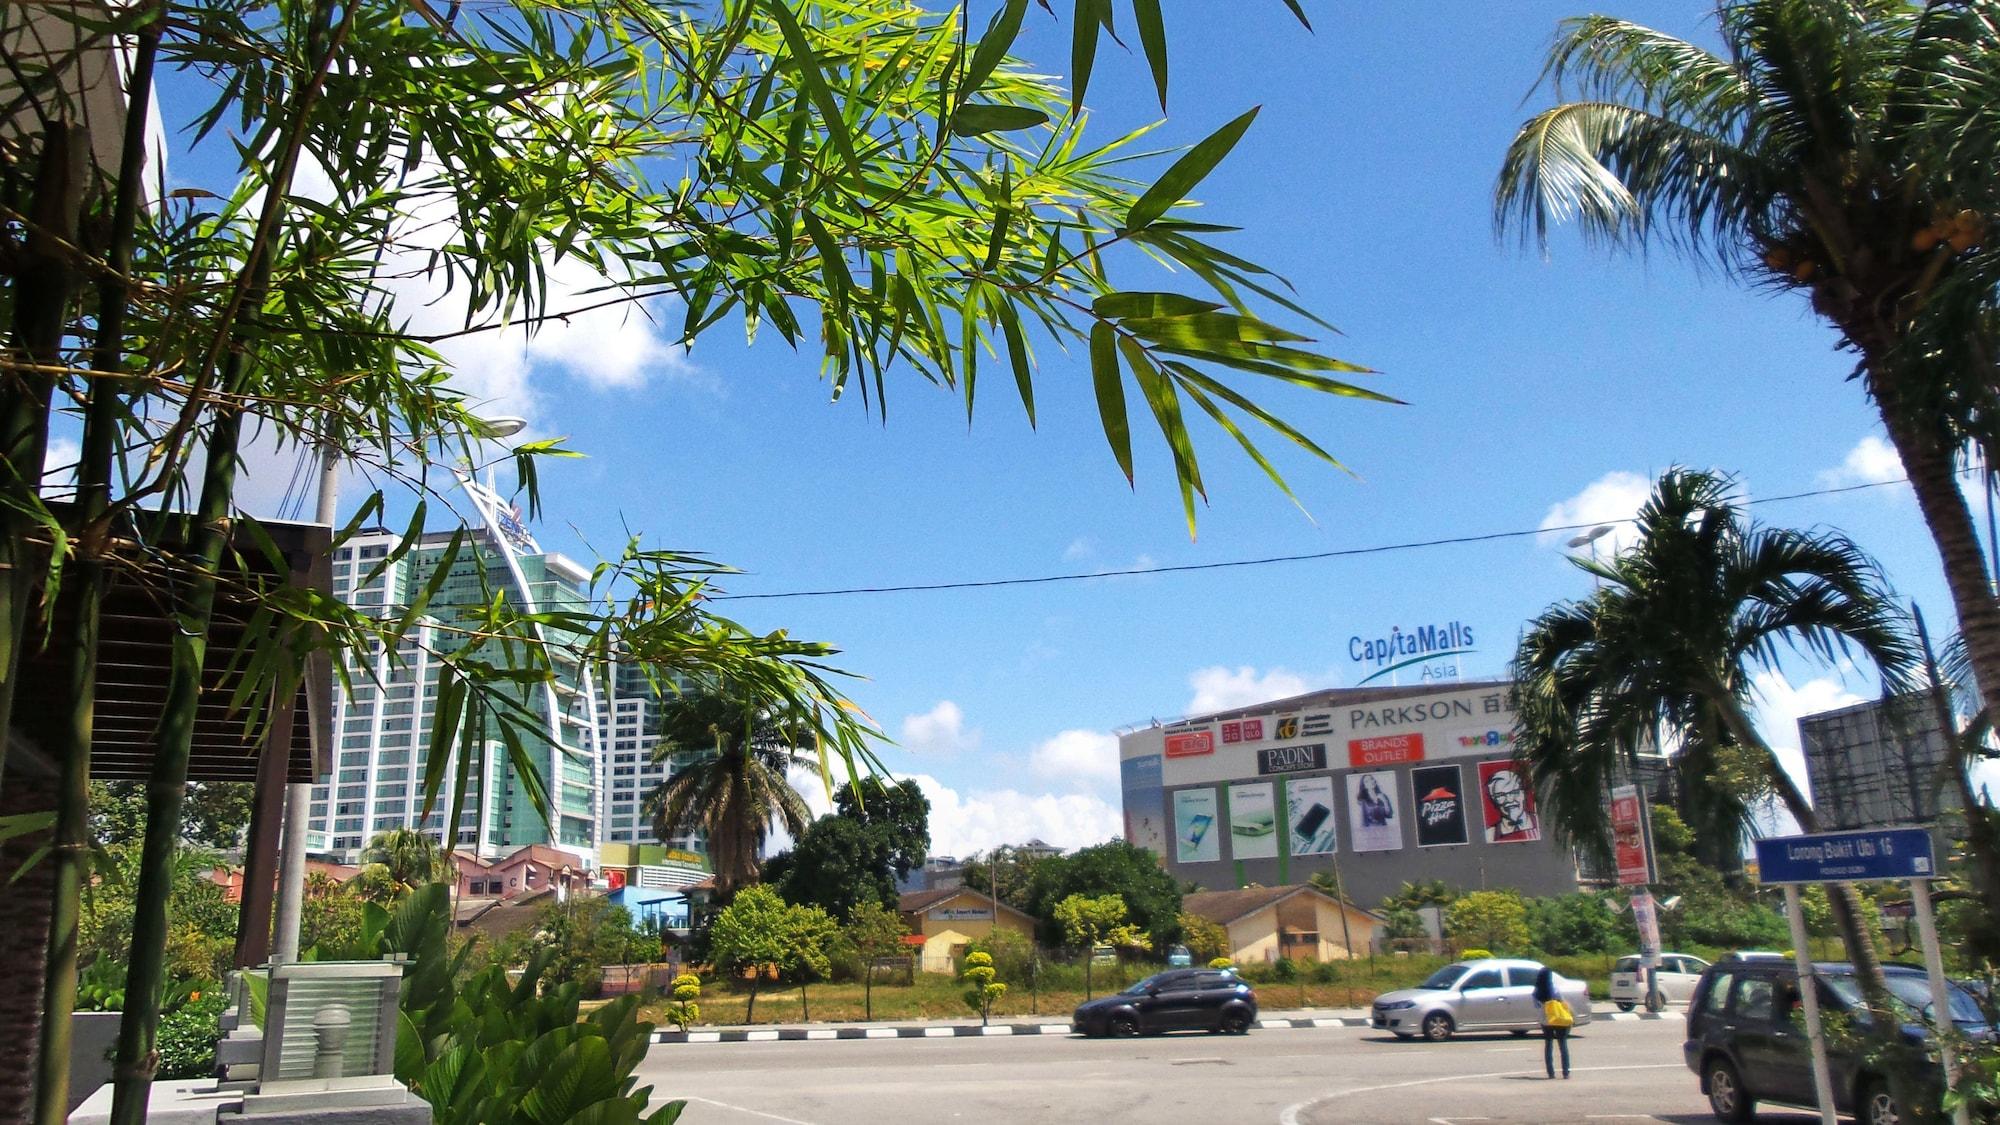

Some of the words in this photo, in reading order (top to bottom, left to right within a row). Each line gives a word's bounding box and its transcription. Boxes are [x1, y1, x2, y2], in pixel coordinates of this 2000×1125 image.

[1349, 621, 1473, 666] CapitaMalls
[1421, 662, 1457, 680] Asia
[1350, 699, 1472, 729] PARKSON
[1361, 736, 1409, 750] BRANDS
[1268, 747, 1314, 766] PADINI
[1364, 749, 1409, 762] OUTLET
[1422, 800, 1455, 817] Pizza
[1428, 809, 1454, 825] Hut
[1787, 843, 1823, 863] Lorong
[1824, 840, 1853, 858] Bukit
[1857, 839, 1875, 857] Ubi
[1881, 838, 1893, 855] 16
[510, 877, 517, 887] C
